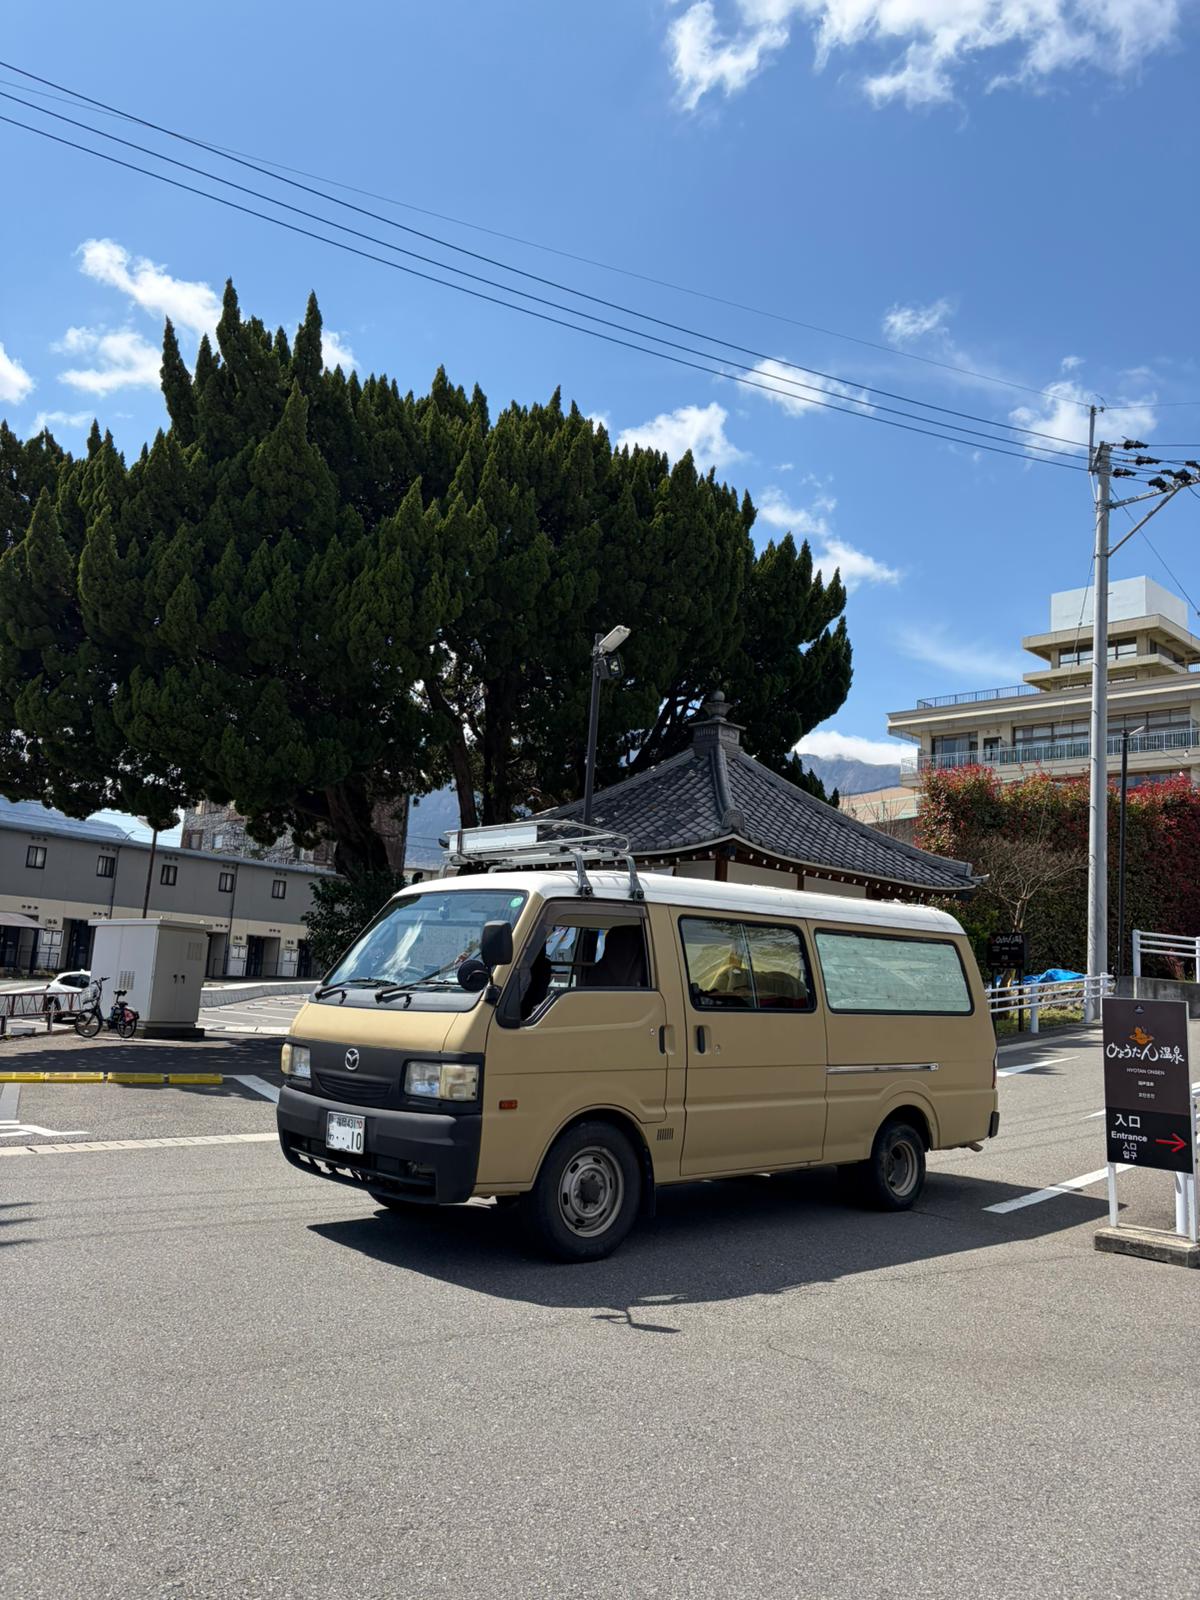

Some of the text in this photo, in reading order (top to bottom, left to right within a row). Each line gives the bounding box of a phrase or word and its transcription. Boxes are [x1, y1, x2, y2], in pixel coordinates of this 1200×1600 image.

[1106, 1042, 1185, 1065] ひょうたん温泉
[1115, 1113, 1141, 1129] 入口
[1111, 1130, 1148, 1142] Entrance
[1122, 1142, 1137, 1151] 入口
